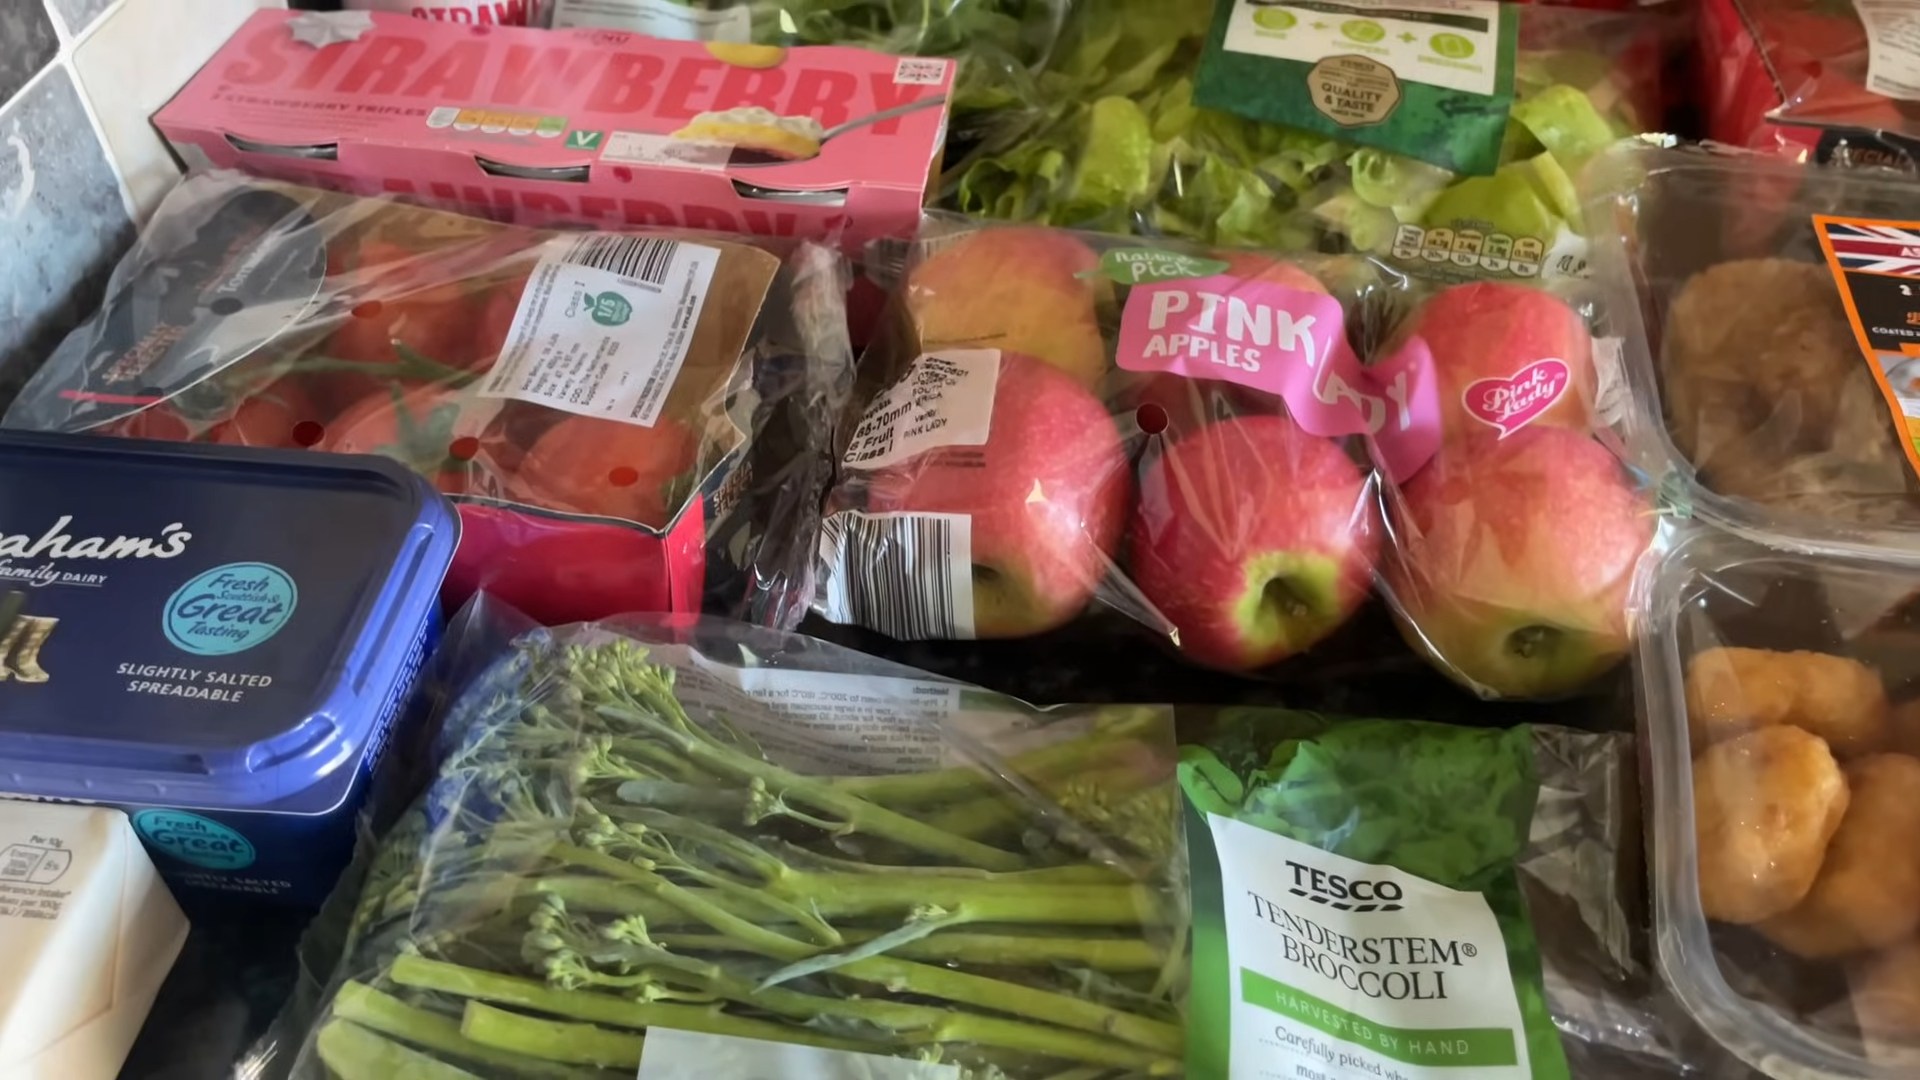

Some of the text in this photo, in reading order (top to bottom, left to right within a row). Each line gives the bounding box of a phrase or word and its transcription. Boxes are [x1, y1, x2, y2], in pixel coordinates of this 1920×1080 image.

[224, 22, 918, 136] STRAWBERRY
[1321, 82, 1382, 103] QUALITY
[1324, 95, 1374, 113] & TASTE
[355, 103, 427, 117] TRIFLES
[1899, 284, 1913, 296] 2
[564, 291, 583, 318] Class
[597, 298, 616, 318] 1/5
[1147, 289, 1316, 368] PINK
[1872, 326, 1914, 337] COATED
[1142, 334, 1261, 373] APPLES
[1482, 367, 1548, 413] Pink
[1496, 379, 1555, 423] Lady
[863, 426, 894, 449] Fruit
[926, 418, 948, 433] LADY
[843, 447, 885, 463] Class
[0, 515, 193, 559] aham's
[62, 572, 108, 584] DAIRY
[208, 573, 270, 592] Fresh
[177, 593, 283, 625] Great
[186, 621, 250, 643] Tasting
[116, 662, 272, 687] SLIGHTLY SALTED
[126, 680, 244, 703] SPREADABLE
[153, 815, 208, 832] Fresh
[151, 828, 245, 854] Great
[1285, 860, 1404, 901] TESCO
[1247, 890, 1478, 967] TENDERSTEM®
[1280, 933, 1448, 1000] BROCCOLI
[1275, 990, 1470, 1056] HARVESTED BY HAND
[1274, 1025, 1335, 1062] Carefully
[1339, 1053, 1382, 1076] picked
[1296, 1064, 1326, 1080] most
